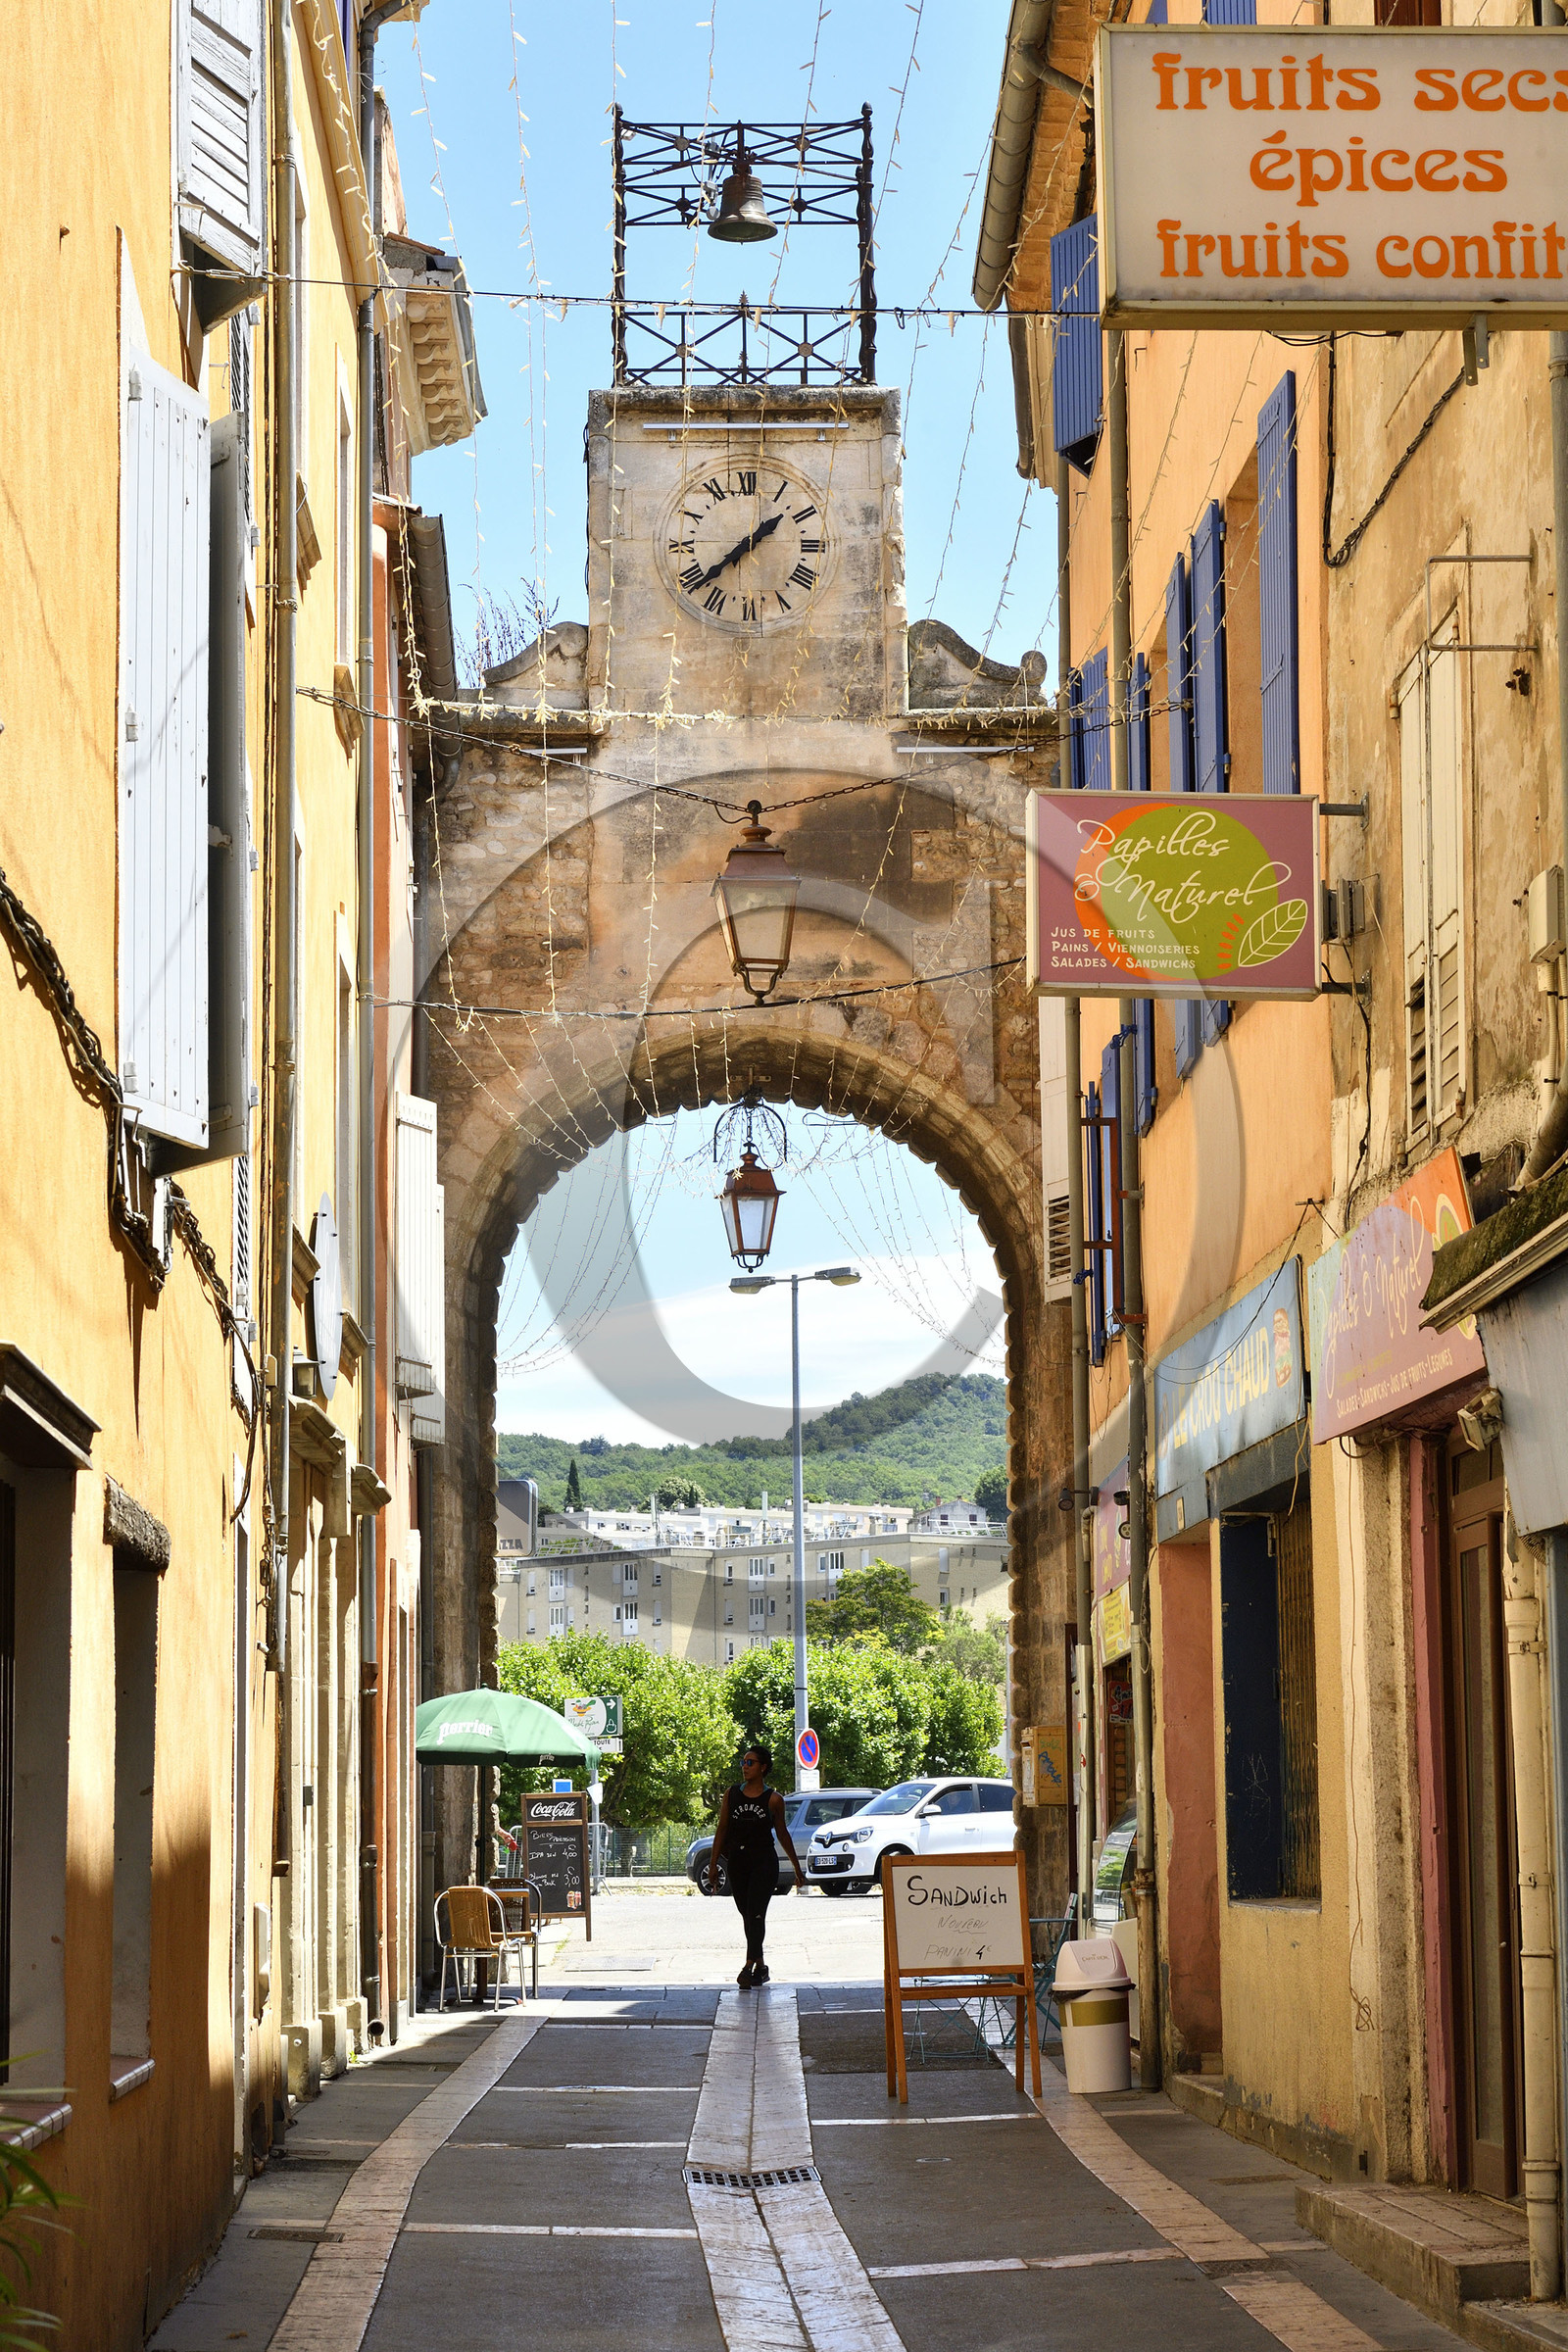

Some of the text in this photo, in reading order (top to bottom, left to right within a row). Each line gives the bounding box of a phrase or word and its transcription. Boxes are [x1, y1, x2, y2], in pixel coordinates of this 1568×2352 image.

[1152, 52, 1381, 111] fruits
[1250, 130, 1507, 207] épices
[1156, 220, 1566, 279] fruits confit
[1077, 811, 1230, 887] Papilles
[1114, 861, 1292, 923] Naturel
[1224, 1326, 1270, 1416] CHAUD
[530, 1801, 577, 1822] Coca-Cola
[732, 1803, 766, 1820] STRONGER
